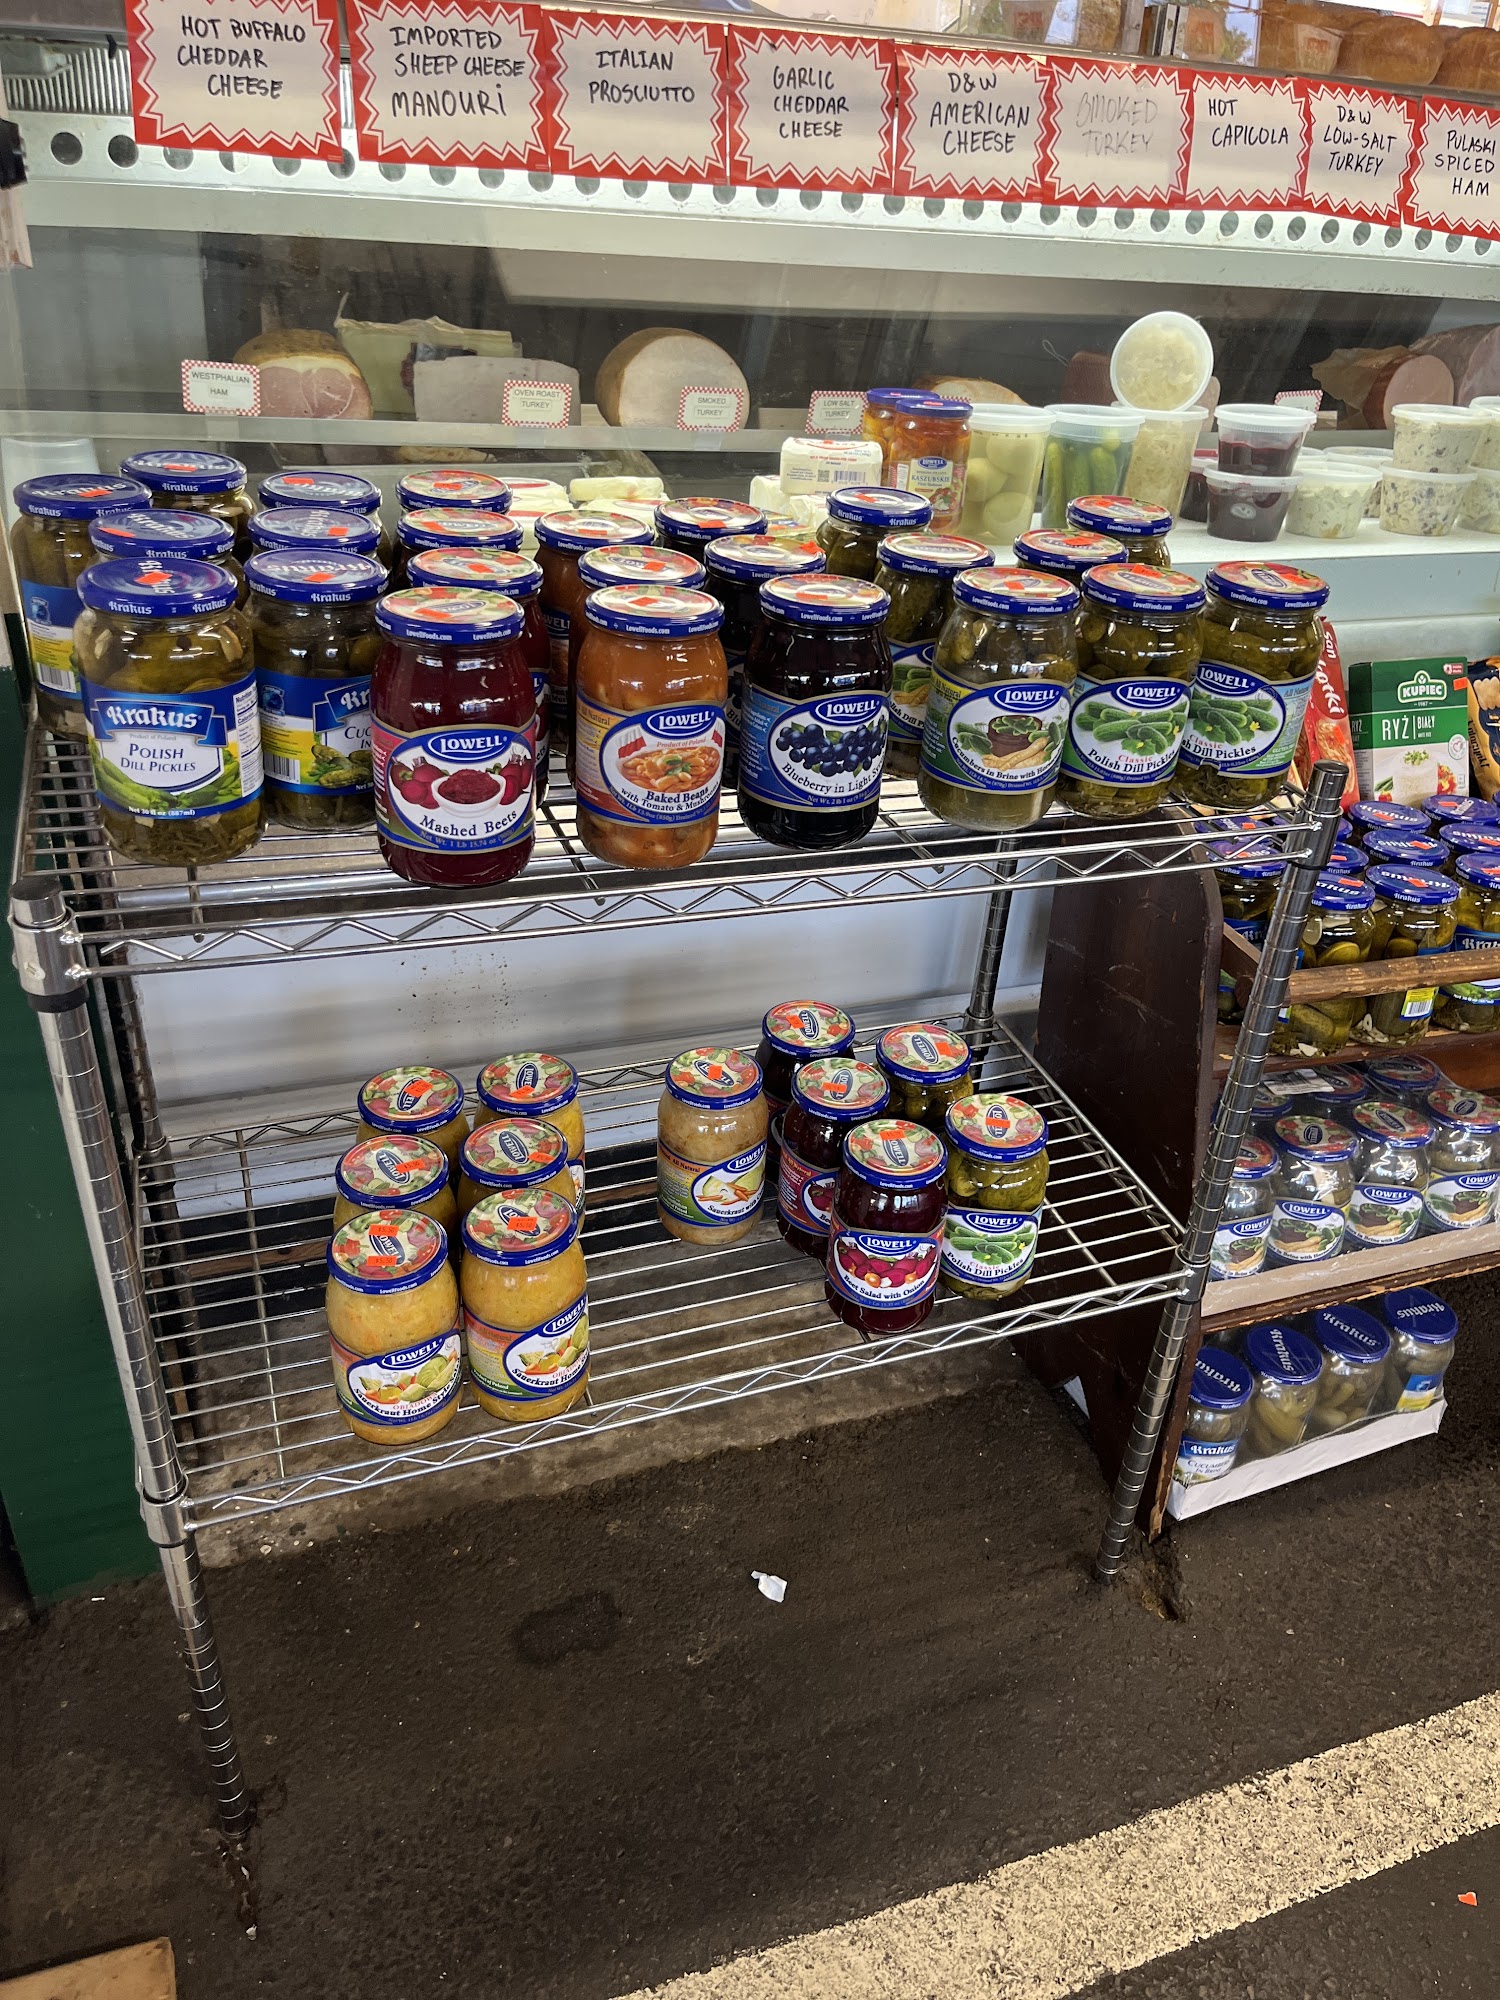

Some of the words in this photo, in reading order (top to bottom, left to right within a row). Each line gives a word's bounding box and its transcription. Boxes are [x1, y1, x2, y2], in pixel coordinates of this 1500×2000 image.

[181, 15, 222, 39] HOT
[229, 18, 306, 43] BUFFALO
[389, 25, 502, 49] IMPORTED
[177, 44, 268, 69] CHEDDAR
[394, 52, 458, 77] SHEEP
[463, 56, 526, 77] CHEESE
[595, 48, 674, 70] ITALIAN
[773, 66, 835, 90] GARLIC
[947, 72, 997, 93] D&W
[207, 74, 283, 99] CHEESE
[588, 79, 695, 103] PROSCIUTTO
[773, 95, 850, 115] CHEDDAR
[1076, 92, 1158, 128] SMOKED
[1208, 98, 1238, 117] HOT
[930, 100, 1030, 128] AMERICAN
[1336, 105, 1371, 125] D&W
[779, 120, 843, 138] CHEESE
[1211, 124, 1289, 147] CAPICOLA
[943, 130, 1016, 156] CHEESE
[1081, 130, 1153, 157] TURKEY
[1323, 125, 1397, 152] LOW-SALT
[1446, 129, 1496, 156] PULASKI
[1328, 151, 1384, 177] TURKEY
[1434, 154, 1495, 174] SPICED
[1452, 177, 1490, 197] HAM
[191, 370, 250, 384] WESTPHALIAN
[210, 387, 228, 396] HAM
[513, 388, 534, 397] OVEN
[535, 390, 560, 398] ROAST
[521, 400, 550, 409] TURKEY
[697, 396, 726, 405] SMOKED
[823, 399, 837, 407] LOW
[838, 399, 855, 407] SALT
[825, 409, 850, 418] TURKEY
[911, 474, 950, 482] KASZUBSKIE
[162, 481, 200, 493] Krakus
[28, 504, 62, 517] Krakus
[837, 509, 864, 522] Krakus
[128, 512, 195, 540] Krakus
[889, 518, 918, 526] Krakus
[1107, 523, 1142, 533] LowellFoods.com
[146, 548, 188, 559] Krakus
[902, 562, 939, 574] LowellFoods.com
[311, 592, 352, 602] Krakus
[972, 595, 1010, 611] LowellFoods.com
[1230, 591, 1268, 606] LowellFoods.com
[108, 600, 154, 615] Krakus
[192, 598, 227, 614] Krakus
[1028, 605, 1064, 614] LowellFoods.com
[1133, 601, 1173, 611] LowellFoods.com
[800, 611, 843, 622] LowellFoods.com
[406, 629, 453, 641] LowellFoods.com
[473, 628, 512, 640] LowellFoods.com
[626, 625, 670, 635] LowellFoods.com
[1199, 667, 1250, 688] LOWELL
[1004, 689, 1056, 704] LOWELL
[1127, 686, 1177, 699] LOWELL
[1402, 686, 1443, 698] KUPIEC
[827, 700, 876, 717] LOWELL
[106, 705, 198, 729] Krakus
[658, 710, 711, 728] LOWELL
[1381, 714, 1410, 741] RYŻ
[1417, 715, 1436, 729] BIAŁY
[129, 733, 149, 741] Product
[441, 735, 502, 750] LOWELL
[688, 738, 707, 747] Poland
[1189, 734, 1222, 750] Classic
[129, 743, 184, 759] POLISH
[952, 737, 986, 774] Cucumbers
[987, 769, 995, 777] in
[996, 772, 1019, 780] Brine
[1019, 770, 1036, 779] with
[1118, 754, 1153, 764] Classic
[1192, 744, 1213, 758] Dill
[1216, 746, 1257, 759] Pickles
[120, 757, 147, 770] DILL
[149, 761, 196, 773] PICKLES
[1087, 748, 1121, 771] Polish
[1123, 763, 1144, 773] Dill
[1146, 750, 1175, 771] Pickles
[781, 763, 832, 795] Blueberry
[834, 783, 845, 794] in
[848, 776, 871, 793] Light
[621, 787, 639, 803] with
[641, 797, 674, 812] Tomato
[676, 803, 684, 811] &
[646, 790, 681, 804] Baked
[682, 786, 709, 803] Beans
[807, 794, 819, 803] Net
[128, 806, 140, 814] Net
[419, 815, 478, 837] Mashed
[484, 810, 517, 833] Beets
[420, 831, 433, 841] Net
[1394, 892, 1421, 903] Krakus
[1345, 902, 1368, 910] Krakus
[801, 1012, 815, 1037] LOWELL
[914, 1035, 935, 1061] LOWELL
[417, 1119, 448, 1132] LowellFoods.com
[501, 1132, 525, 1161] LOWELL
[735, 1144, 764, 1169] LOWELL
[680, 1161, 700, 1173] Natural
[1465, 1174, 1498, 1185] LOWELL
[1371, 1189, 1408, 1199] LOWELL
[707, 1204, 745, 1215] Sauerkraut
[1289, 1204, 1326, 1215] LOWELL
[974, 1215, 1018, 1226] LOWELL
[1240, 1218, 1271, 1233] LOWELL
[867, 1237, 913, 1248] LOWELL
[946, 1251, 972, 1272] Polish
[974, 1266, 992, 1277] Dill
[994, 1258, 1024, 1276] Pickles
[969, 1261, 999, 1270] Classic
[380, 1282, 418, 1295] LowellFoods.com
[843, 1274, 858, 1290] Beet
[860, 1286, 882, 1299] Salad
[883, 1290, 901, 1299] with
[902, 1281, 925, 1297] Onion
[551, 1299, 584, 1332] LOWELL
[1396, 1302, 1445, 1319] Krakus
[1322, 1312, 1379, 1347] Krakus
[390, 1341, 439, 1365] LOWELL
[1270, 1328, 1296, 1373] Krakus
[511, 1368, 559, 1386] Sauerkraut
[560, 1363, 581, 1382] Home
[353, 1387, 400, 1417] Sauerkraut
[402, 1402, 432, 1416] Home
[433, 1384, 451, 1404] Style
[1190, 1444, 1236, 1455] Krakus
